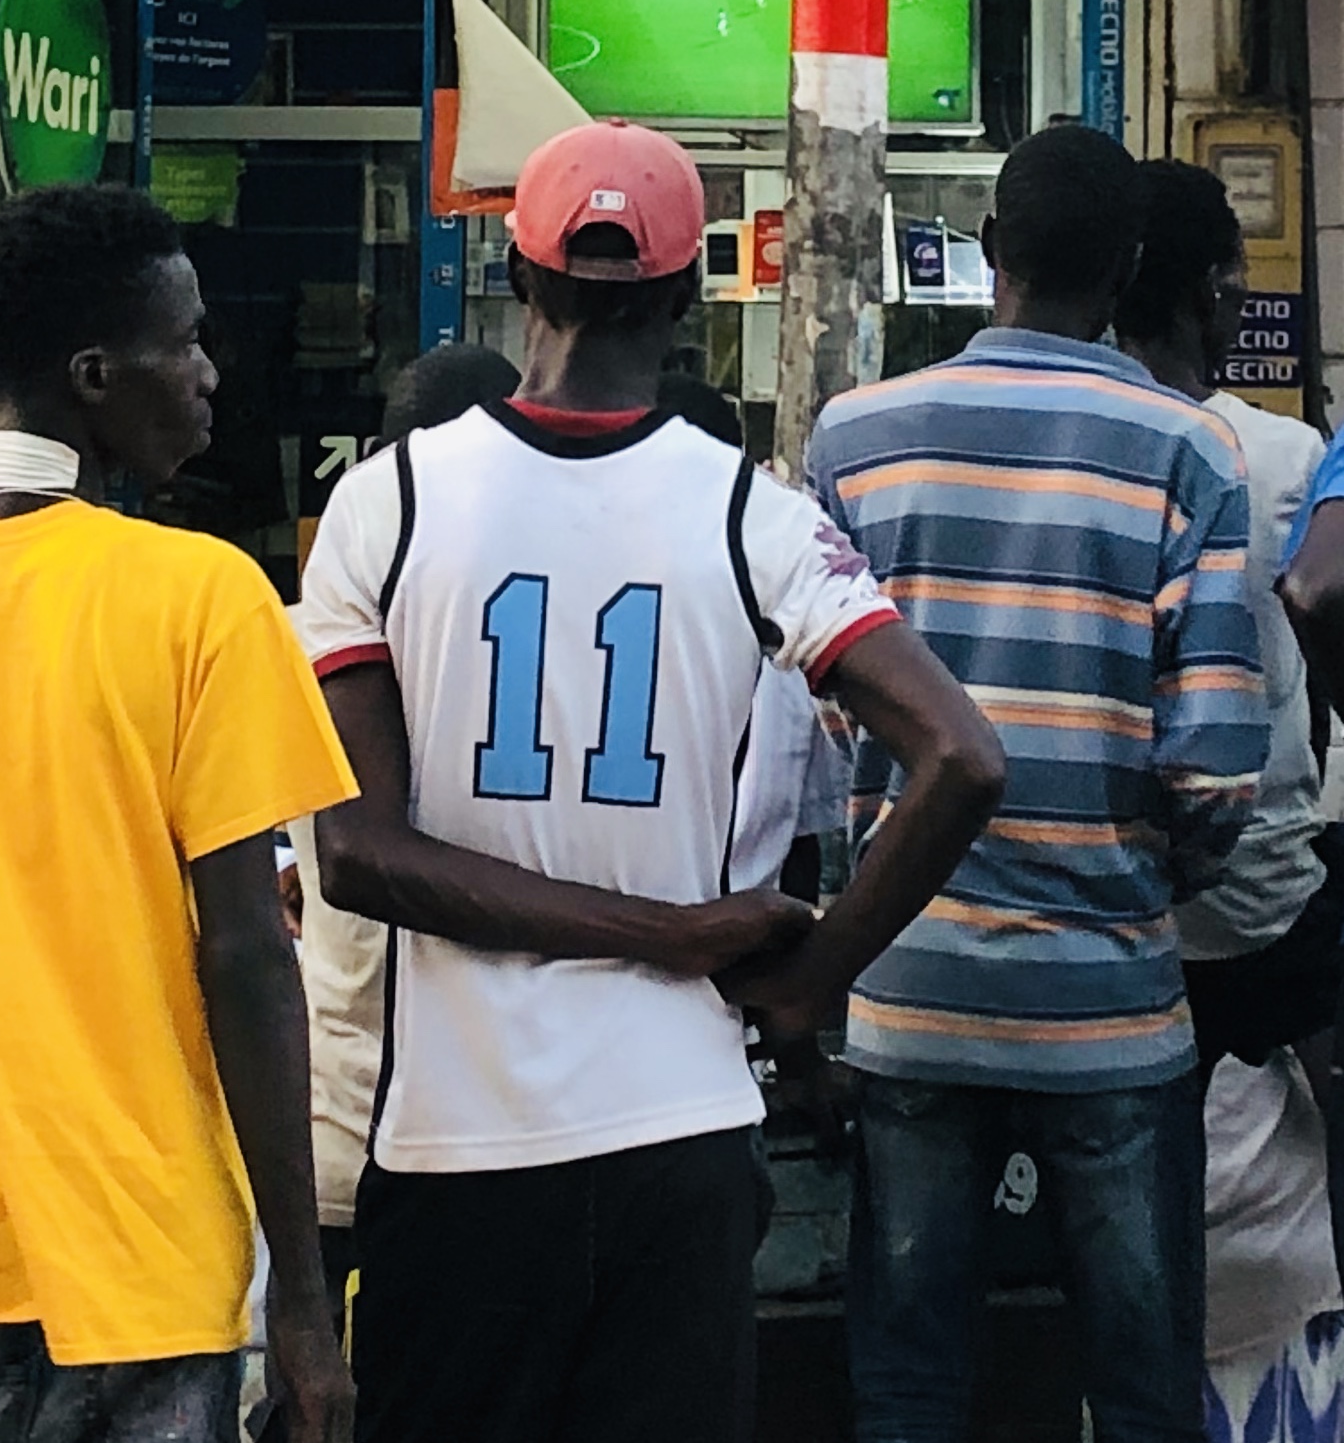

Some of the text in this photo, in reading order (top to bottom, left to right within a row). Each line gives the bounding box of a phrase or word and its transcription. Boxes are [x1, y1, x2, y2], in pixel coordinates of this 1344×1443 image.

[3, 27, 101, 136] Wari
[1239, 299, 1291, 319] CNO
[1237, 329, 1290, 349] CNO
[1223, 361, 1293, 381] ECNO
[473, 572, 666, 808] 11
